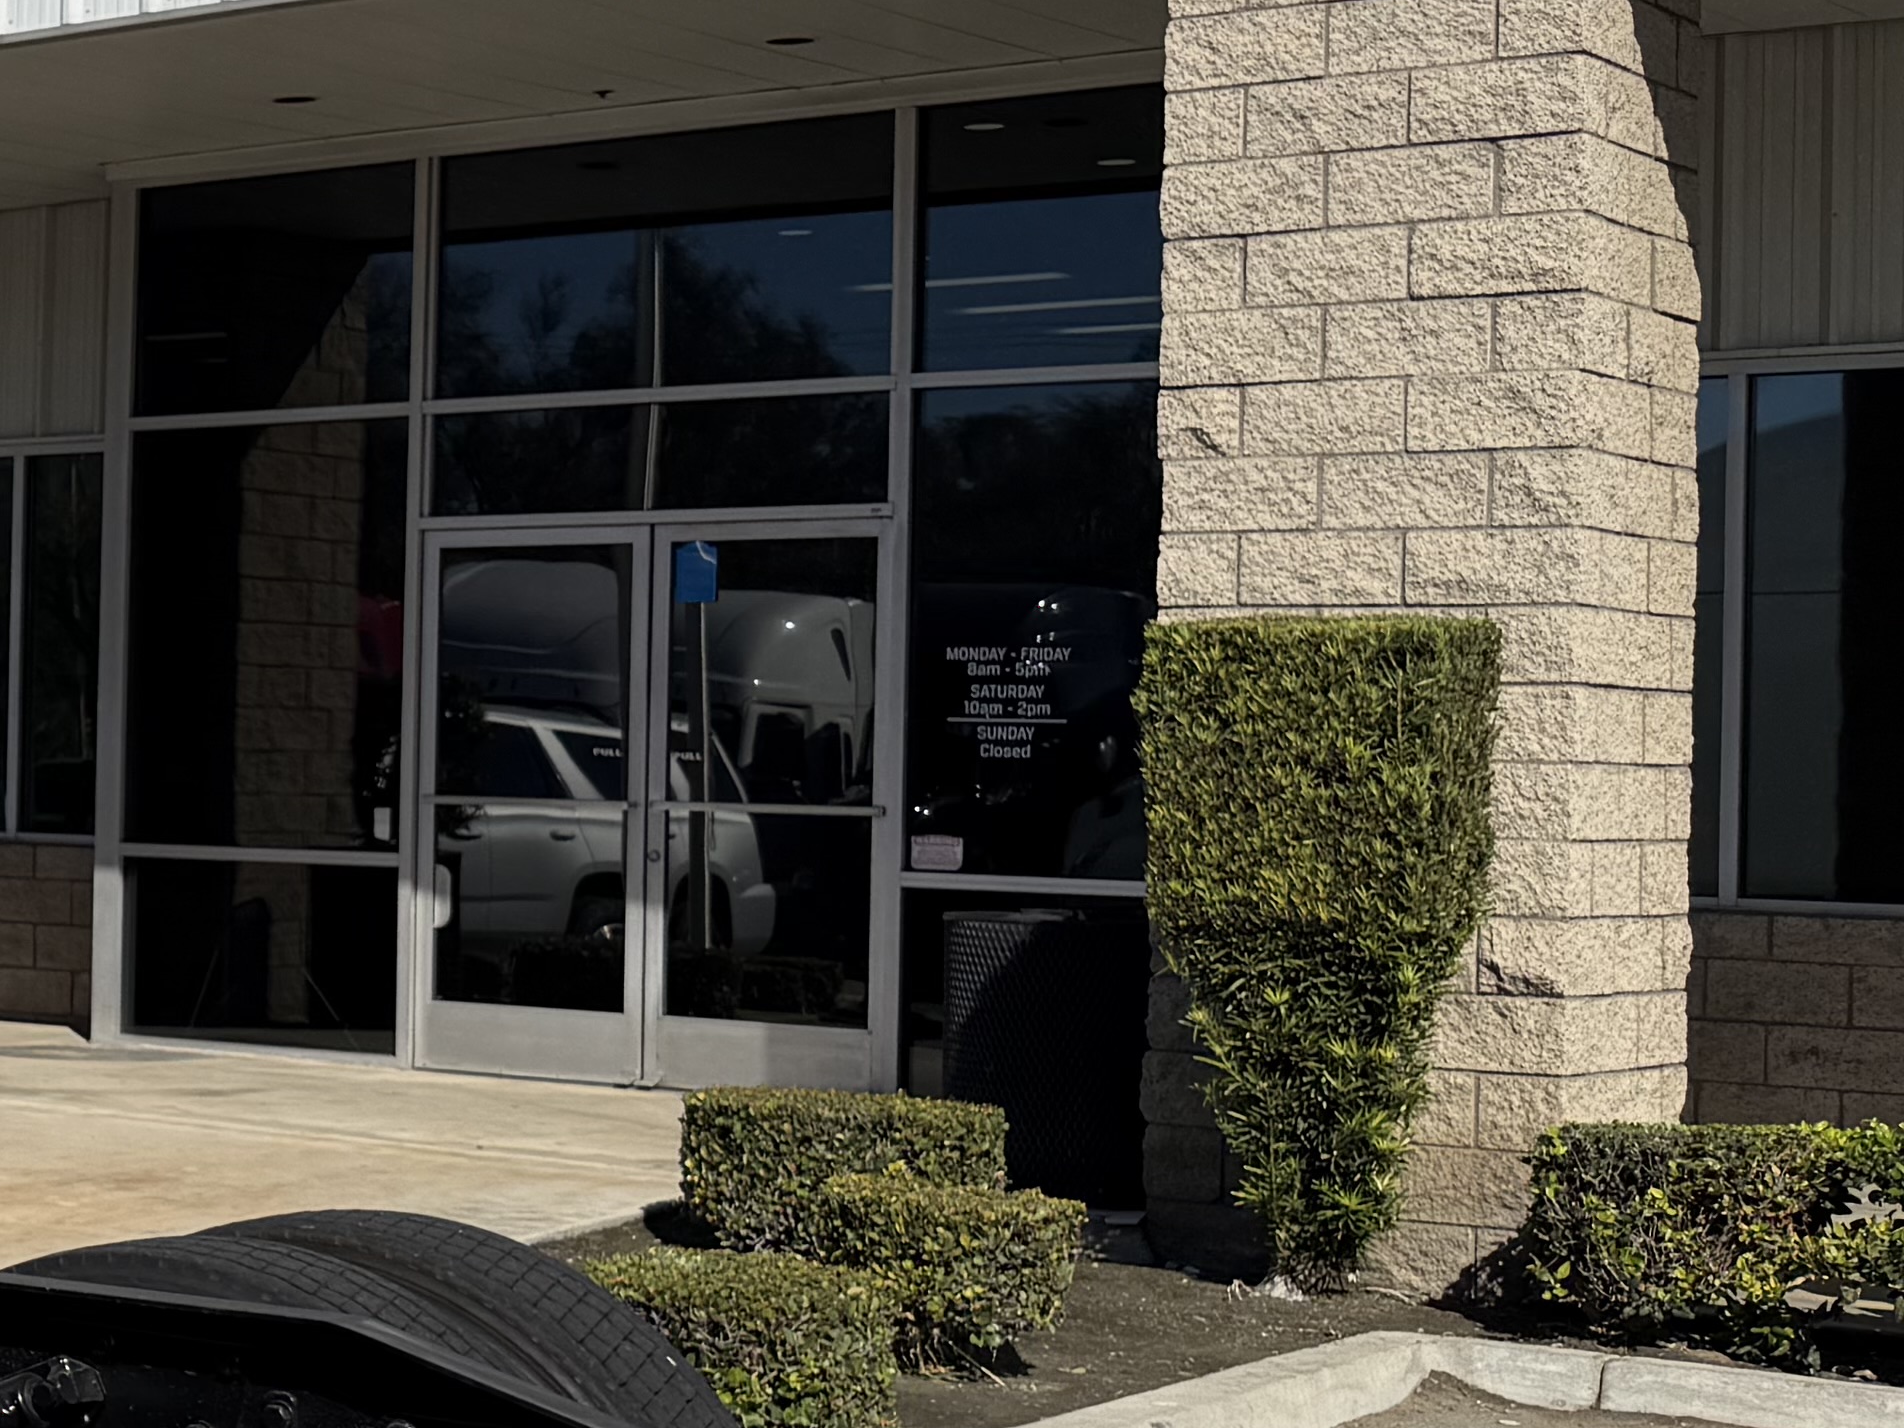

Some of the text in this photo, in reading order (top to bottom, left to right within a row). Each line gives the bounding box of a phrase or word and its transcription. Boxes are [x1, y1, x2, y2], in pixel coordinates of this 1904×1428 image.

[946, 647, 1007, 661] MONDAY
[1020, 647, 1071, 661] FRIDAY
[967, 662, 1000, 676] 8am
[1015, 662, 1051, 678] 5pm
[970, 684, 1044, 698] SATURDAY
[964, 700, 1003, 715] 10am
[1017, 701, 1050, 717] 2pm
[977, 725, 1034, 740] SUNDAY
[980, 743, 1031, 758] Closed
